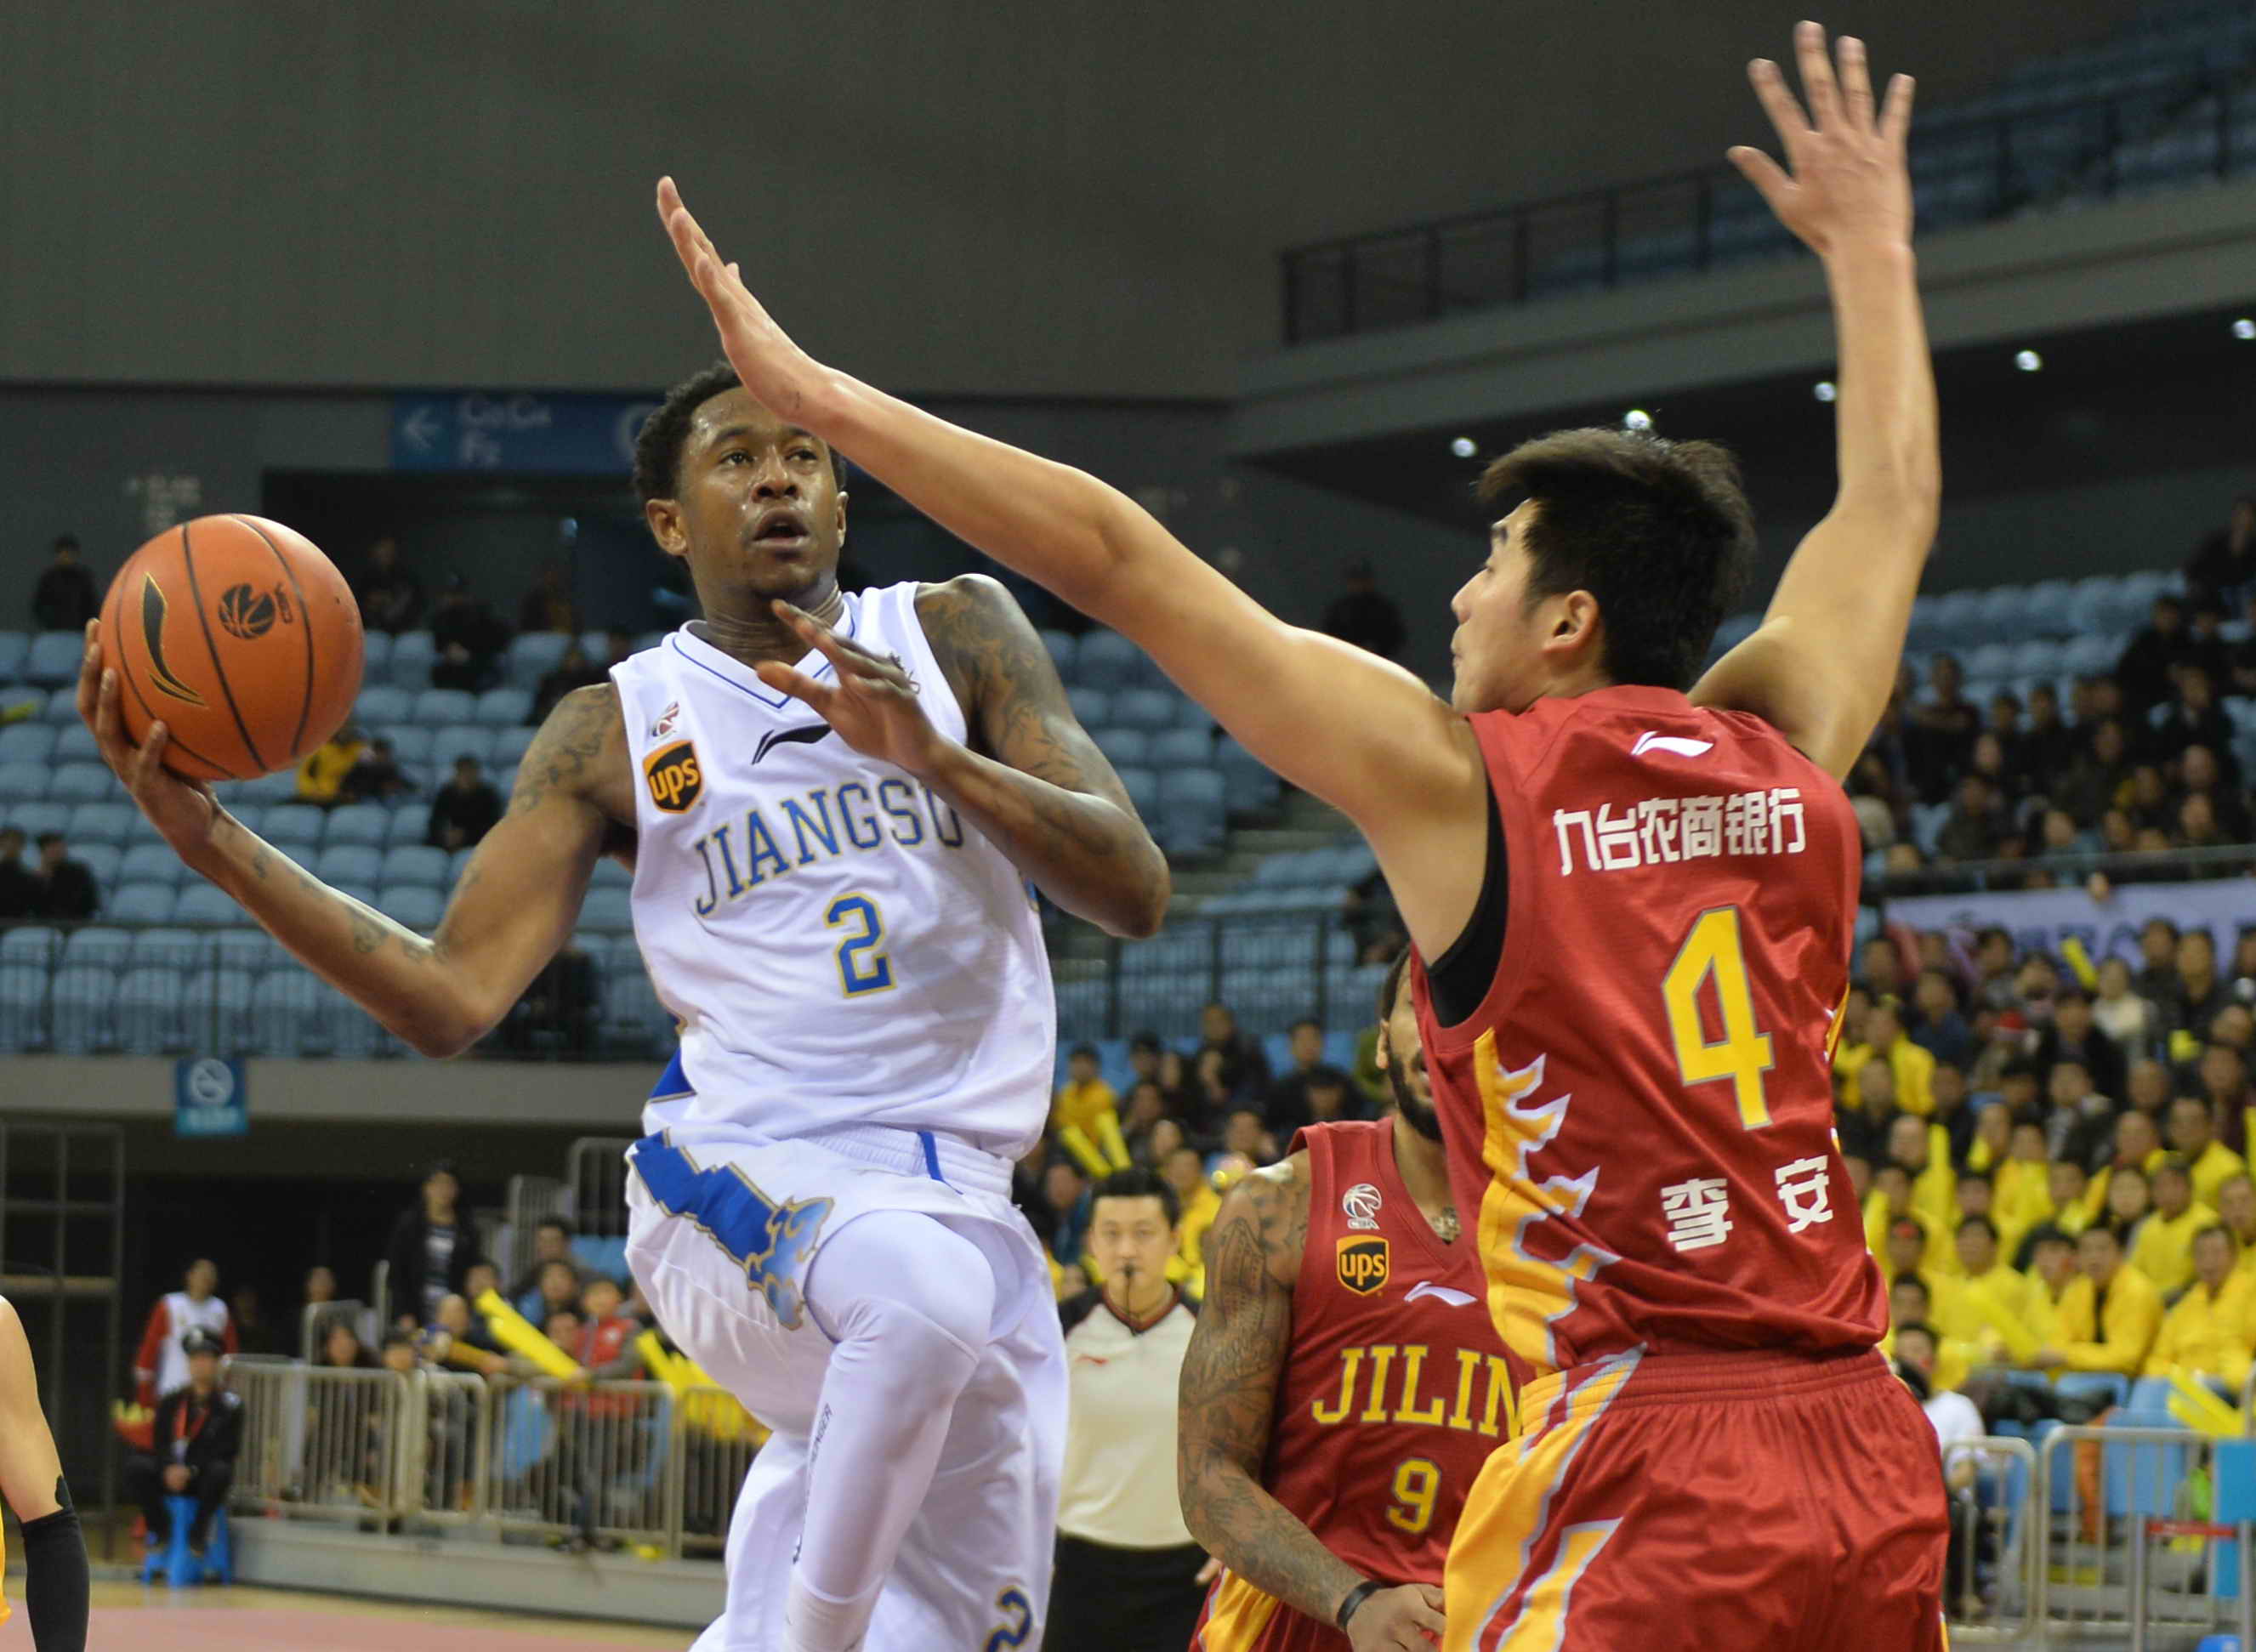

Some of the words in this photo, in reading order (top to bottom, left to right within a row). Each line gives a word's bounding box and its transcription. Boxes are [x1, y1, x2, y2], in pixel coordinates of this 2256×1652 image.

[650, 758, 699, 805] ups
[693, 777, 966, 917] JIANGSU
[1553, 787, 1806, 877] 九台农商银行
[823, 891, 897, 999] 2
[1661, 904, 1776, 1132] 4
[1340, 1253, 1386, 1286] ups
[1311, 1344, 1524, 1442] JILIN
[1386, 1456, 1442, 1534] 9
